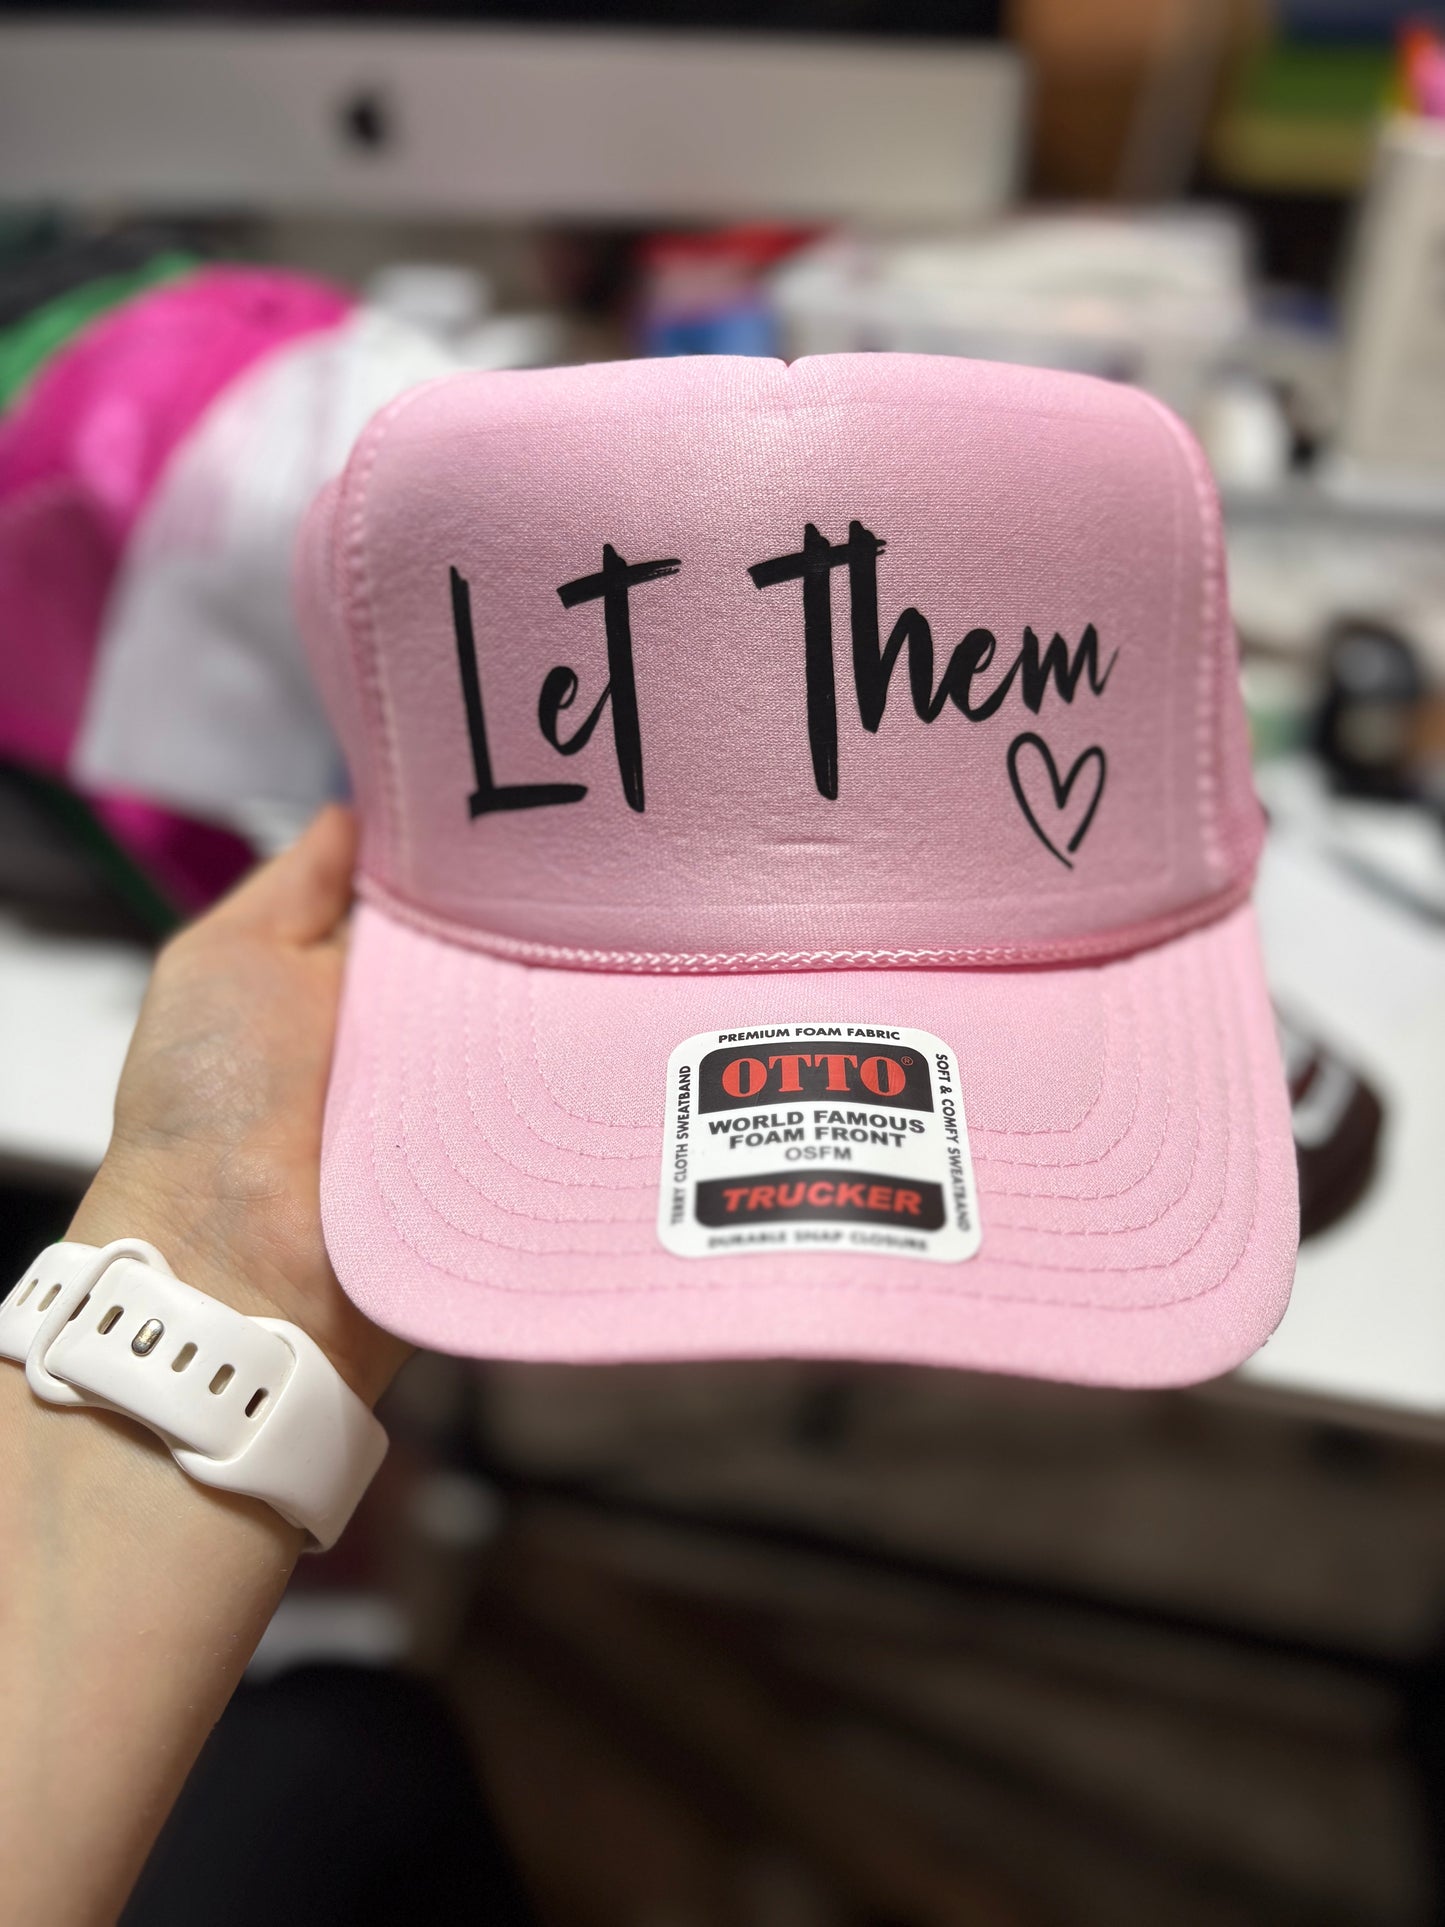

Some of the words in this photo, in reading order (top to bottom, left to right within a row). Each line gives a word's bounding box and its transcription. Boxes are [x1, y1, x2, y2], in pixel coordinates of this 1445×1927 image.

[449, 543, 681, 822] Let
[748, 520, 1119, 801] Them
[718, 1028, 790, 1043] PREMIUM
[795, 1027, 842, 1036] FOAM
[847, 1028, 900, 1040] FABRIC
[935, 1053, 951, 1083] SOFT
[676, 1065, 691, 1140] SWEATBAND
[940, 1086, 953, 1095] &
[708, 1111, 804, 1136] WORLD
[813, 1110, 926, 1134] FAMOUS
[941, 1098, 960, 1144] COMFY
[729, 1128, 805, 1150] FOAM
[815, 1127, 906, 1148] FRONT
[784, 1146, 852, 1161] OSFM
[673, 1143, 689, 1182] CLOTH
[722, 1182, 922, 1215] TRUCKER
